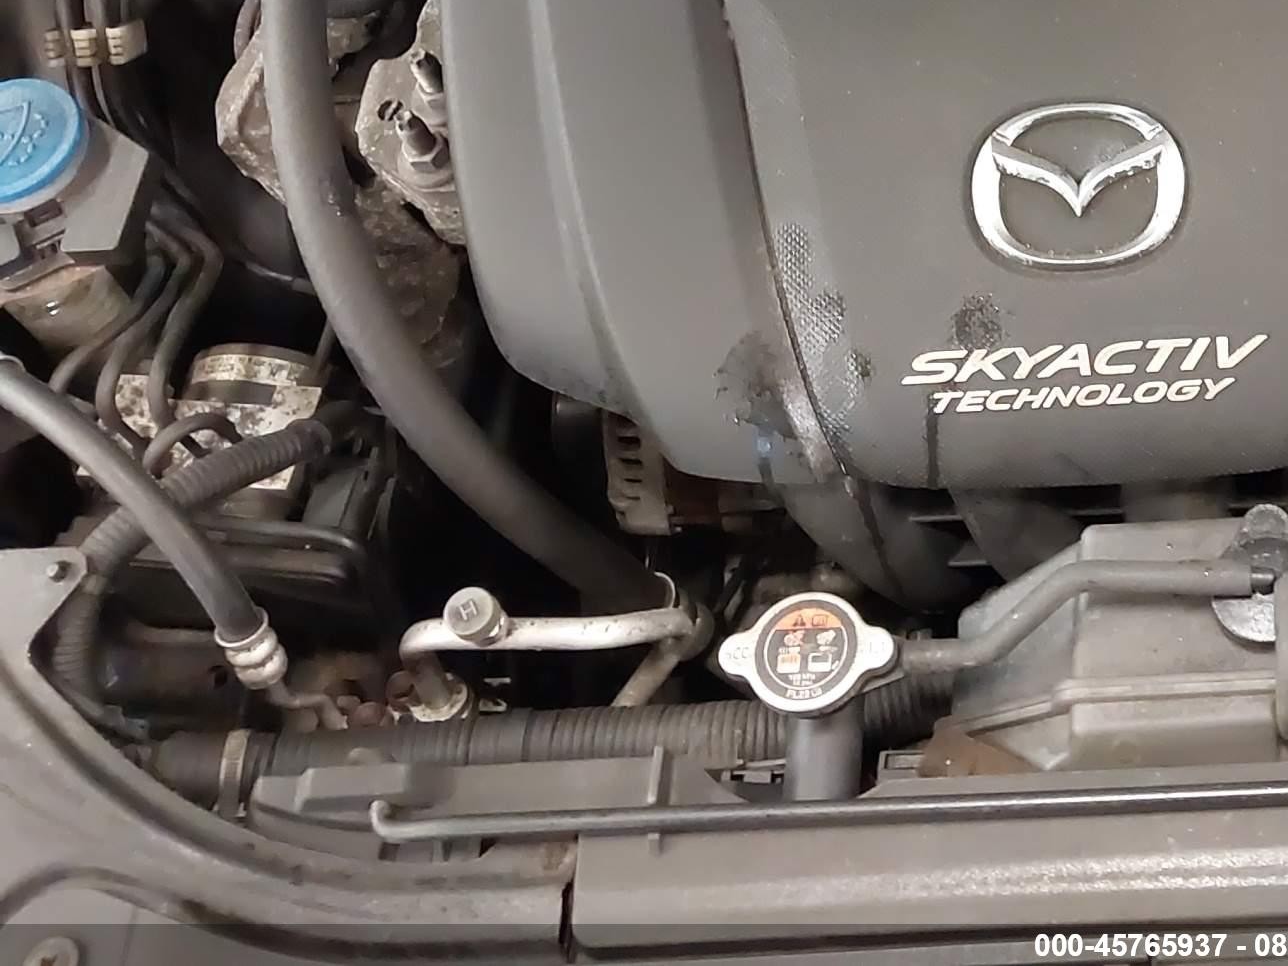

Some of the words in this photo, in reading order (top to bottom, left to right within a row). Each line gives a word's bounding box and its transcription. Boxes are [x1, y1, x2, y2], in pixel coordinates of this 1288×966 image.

[901, 334, 1269, 385] SKYACTIV
[931, 377, 1236, 414] TECHNOLOGY
[459, 599, 478, 621] H
